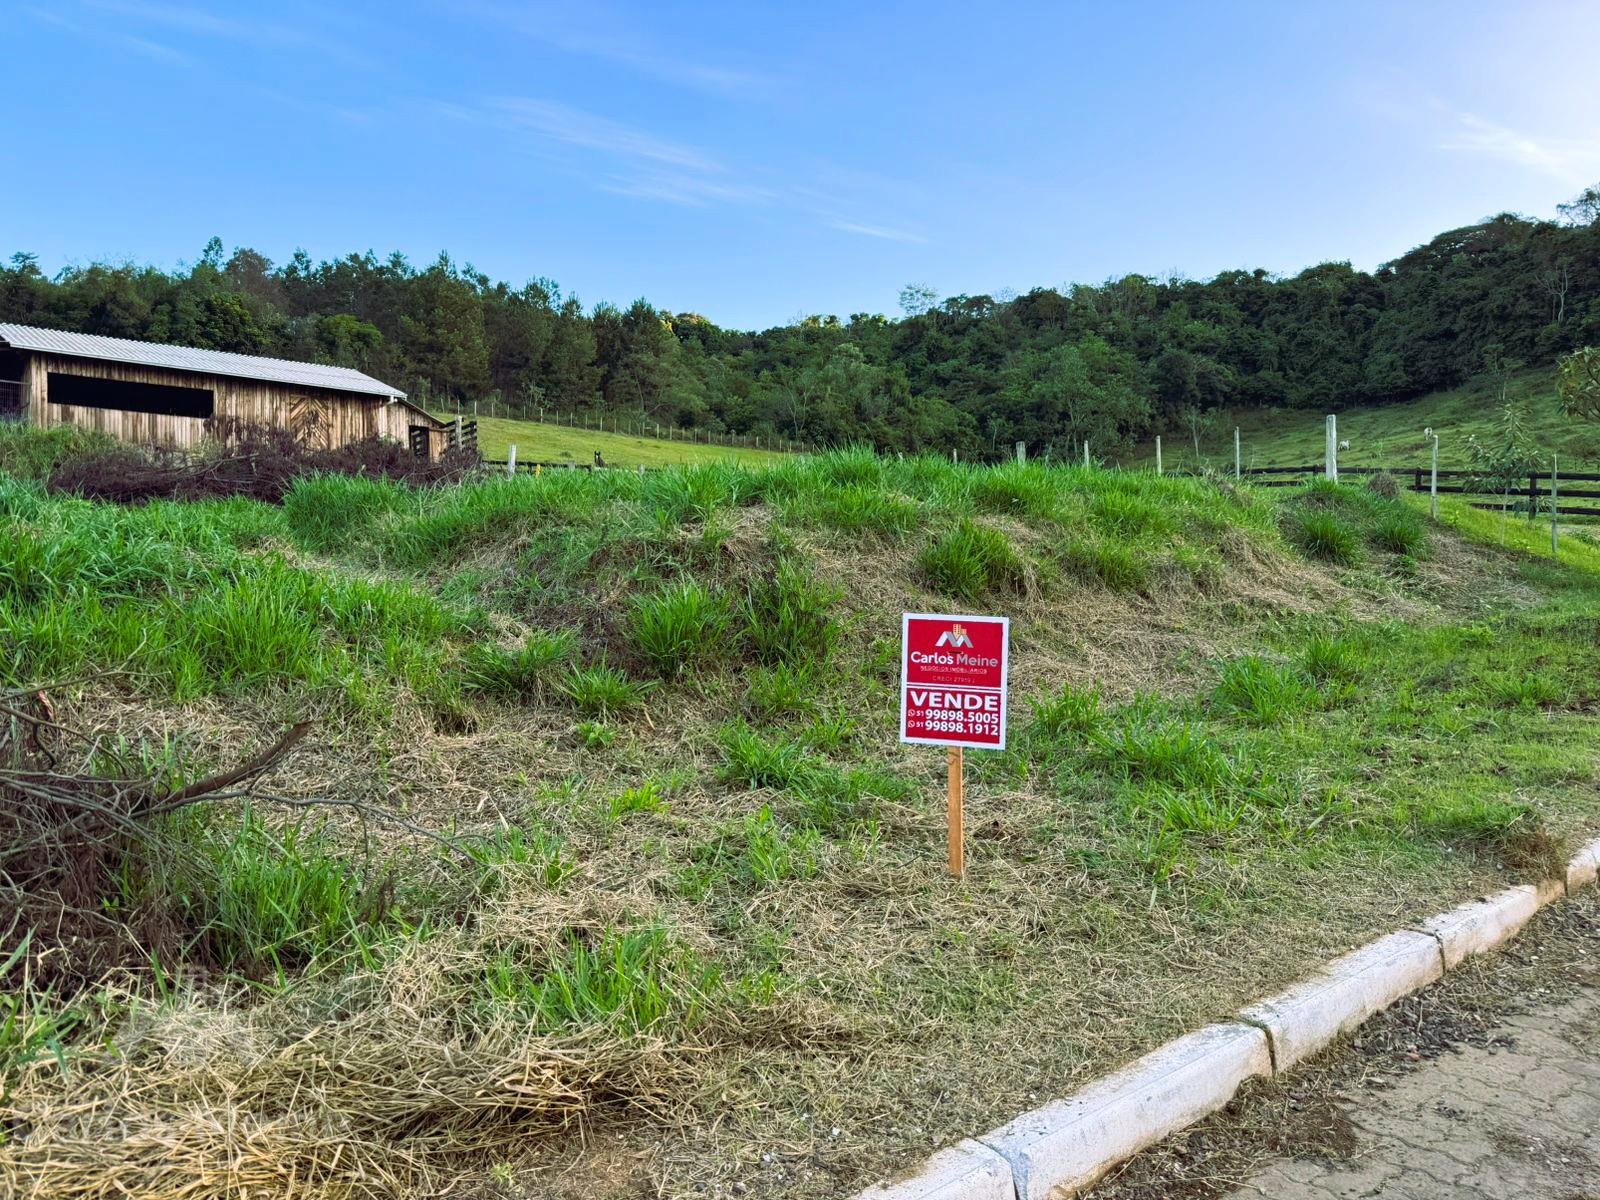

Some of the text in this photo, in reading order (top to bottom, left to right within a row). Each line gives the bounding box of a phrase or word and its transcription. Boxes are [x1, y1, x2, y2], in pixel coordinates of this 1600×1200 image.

[911, 651, 998, 667] Carlos Meine
[910, 691, 998, 712] VENDE
[925, 709, 999, 724] 99898.5005
[925, 720, 999, 736] 99898.1912
